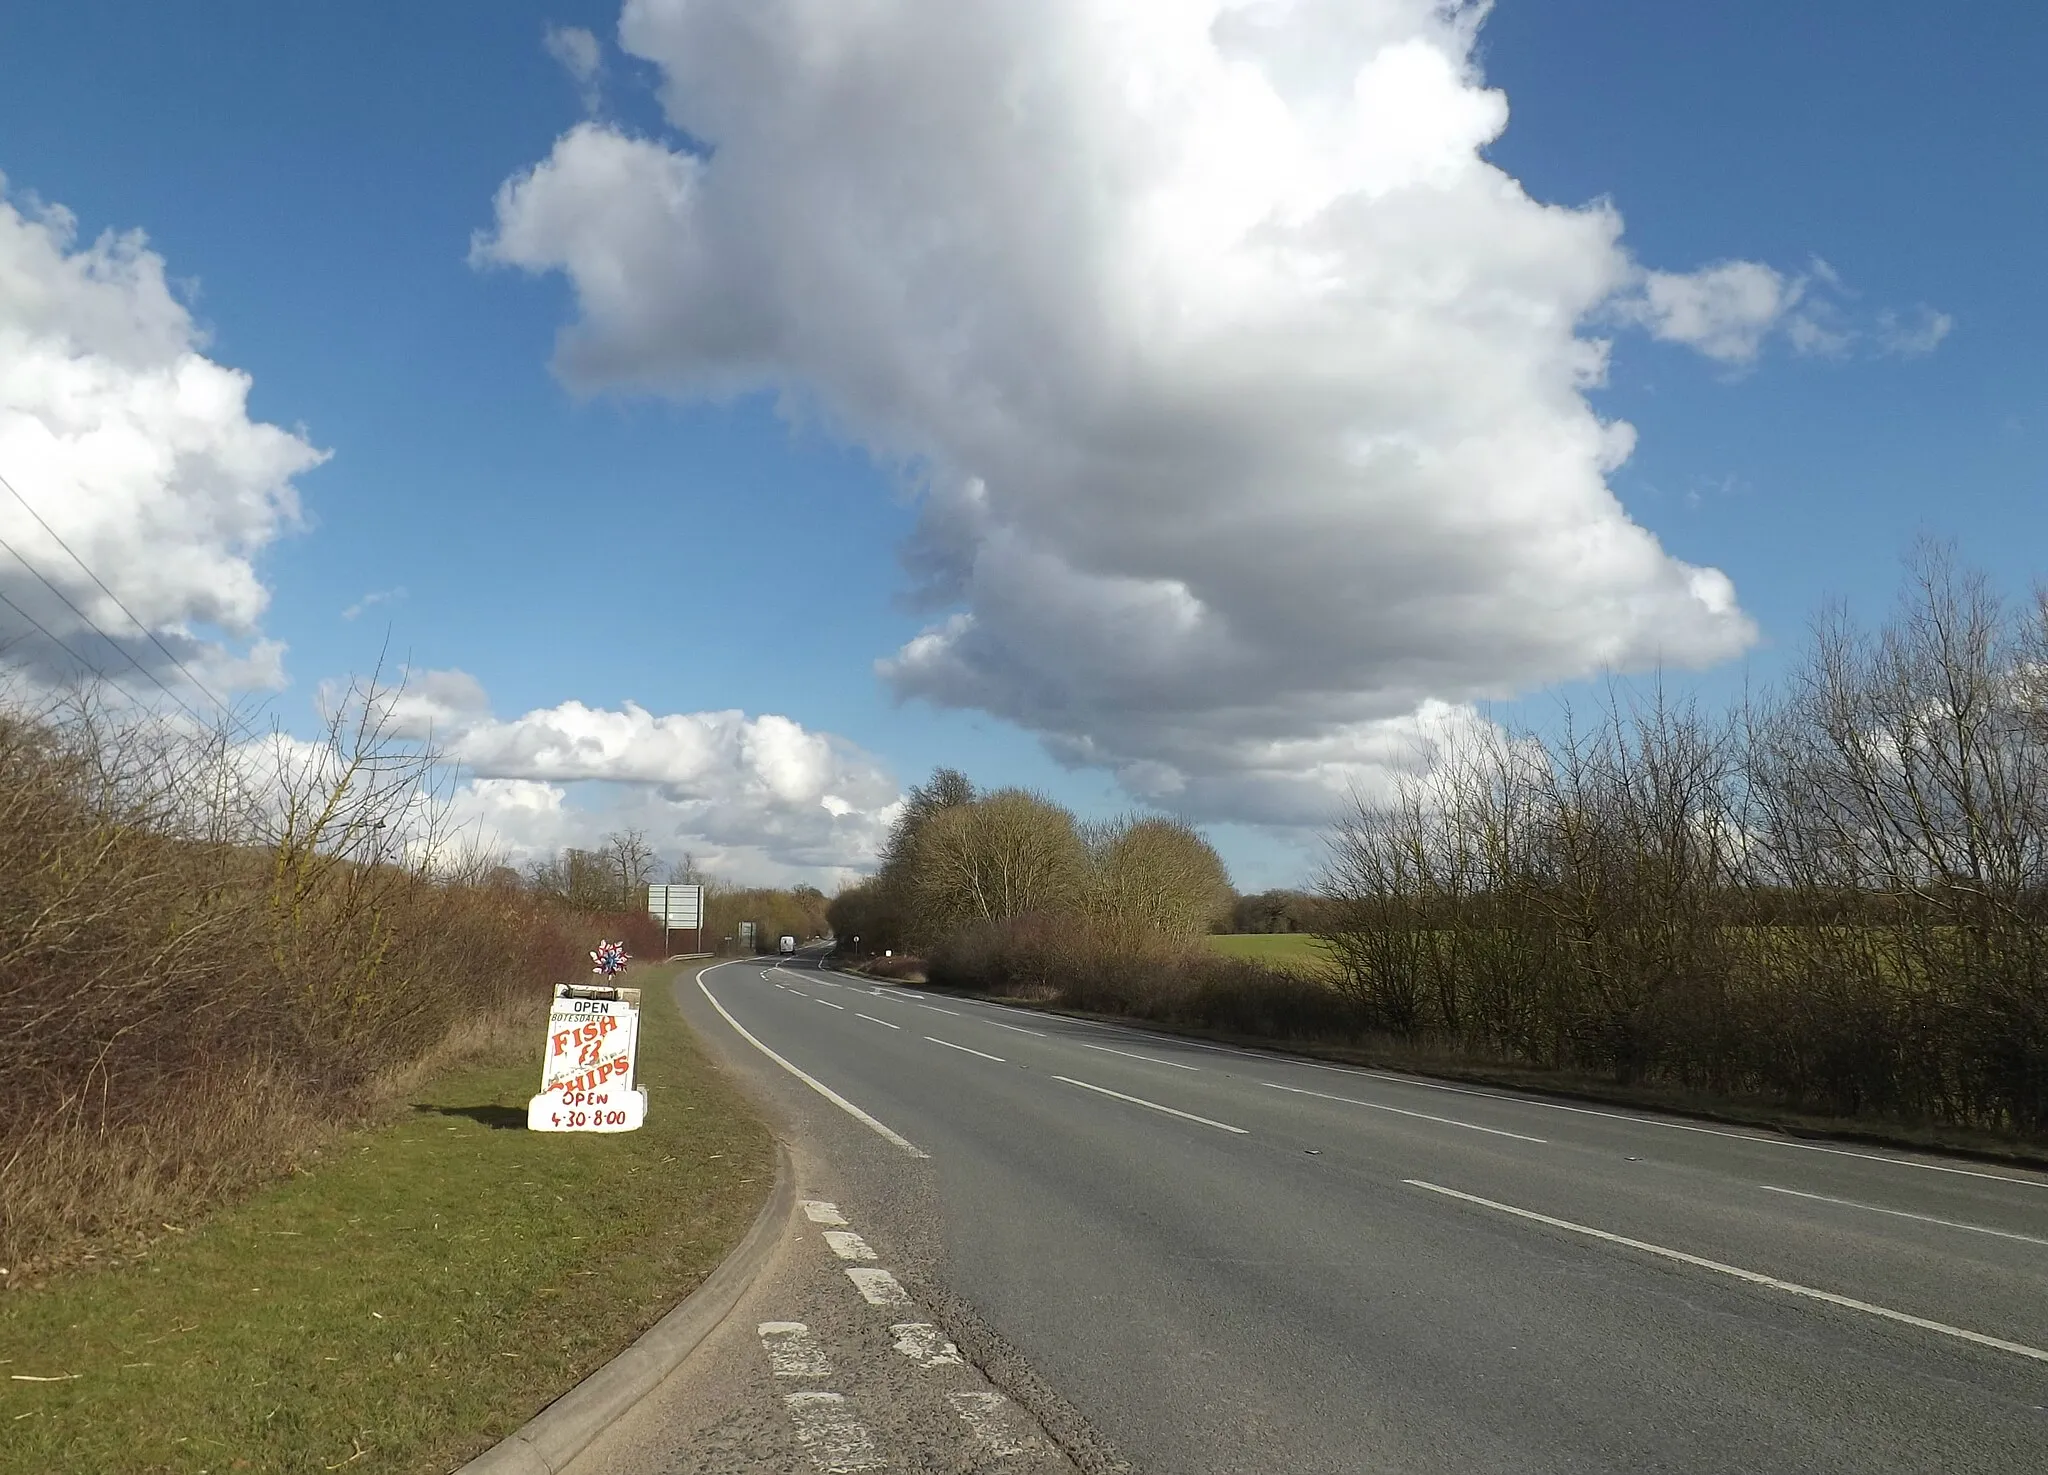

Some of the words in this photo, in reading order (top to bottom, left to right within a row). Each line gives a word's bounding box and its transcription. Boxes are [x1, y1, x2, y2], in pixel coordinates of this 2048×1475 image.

[574, 1001, 609, 1013] OPEN
[551, 1013, 601, 1022] BOTESDALE
[552, 1016, 618, 1056] FISH
[579, 1039, 602, 1066] &
[562, 1091, 608, 1107] OPEN
